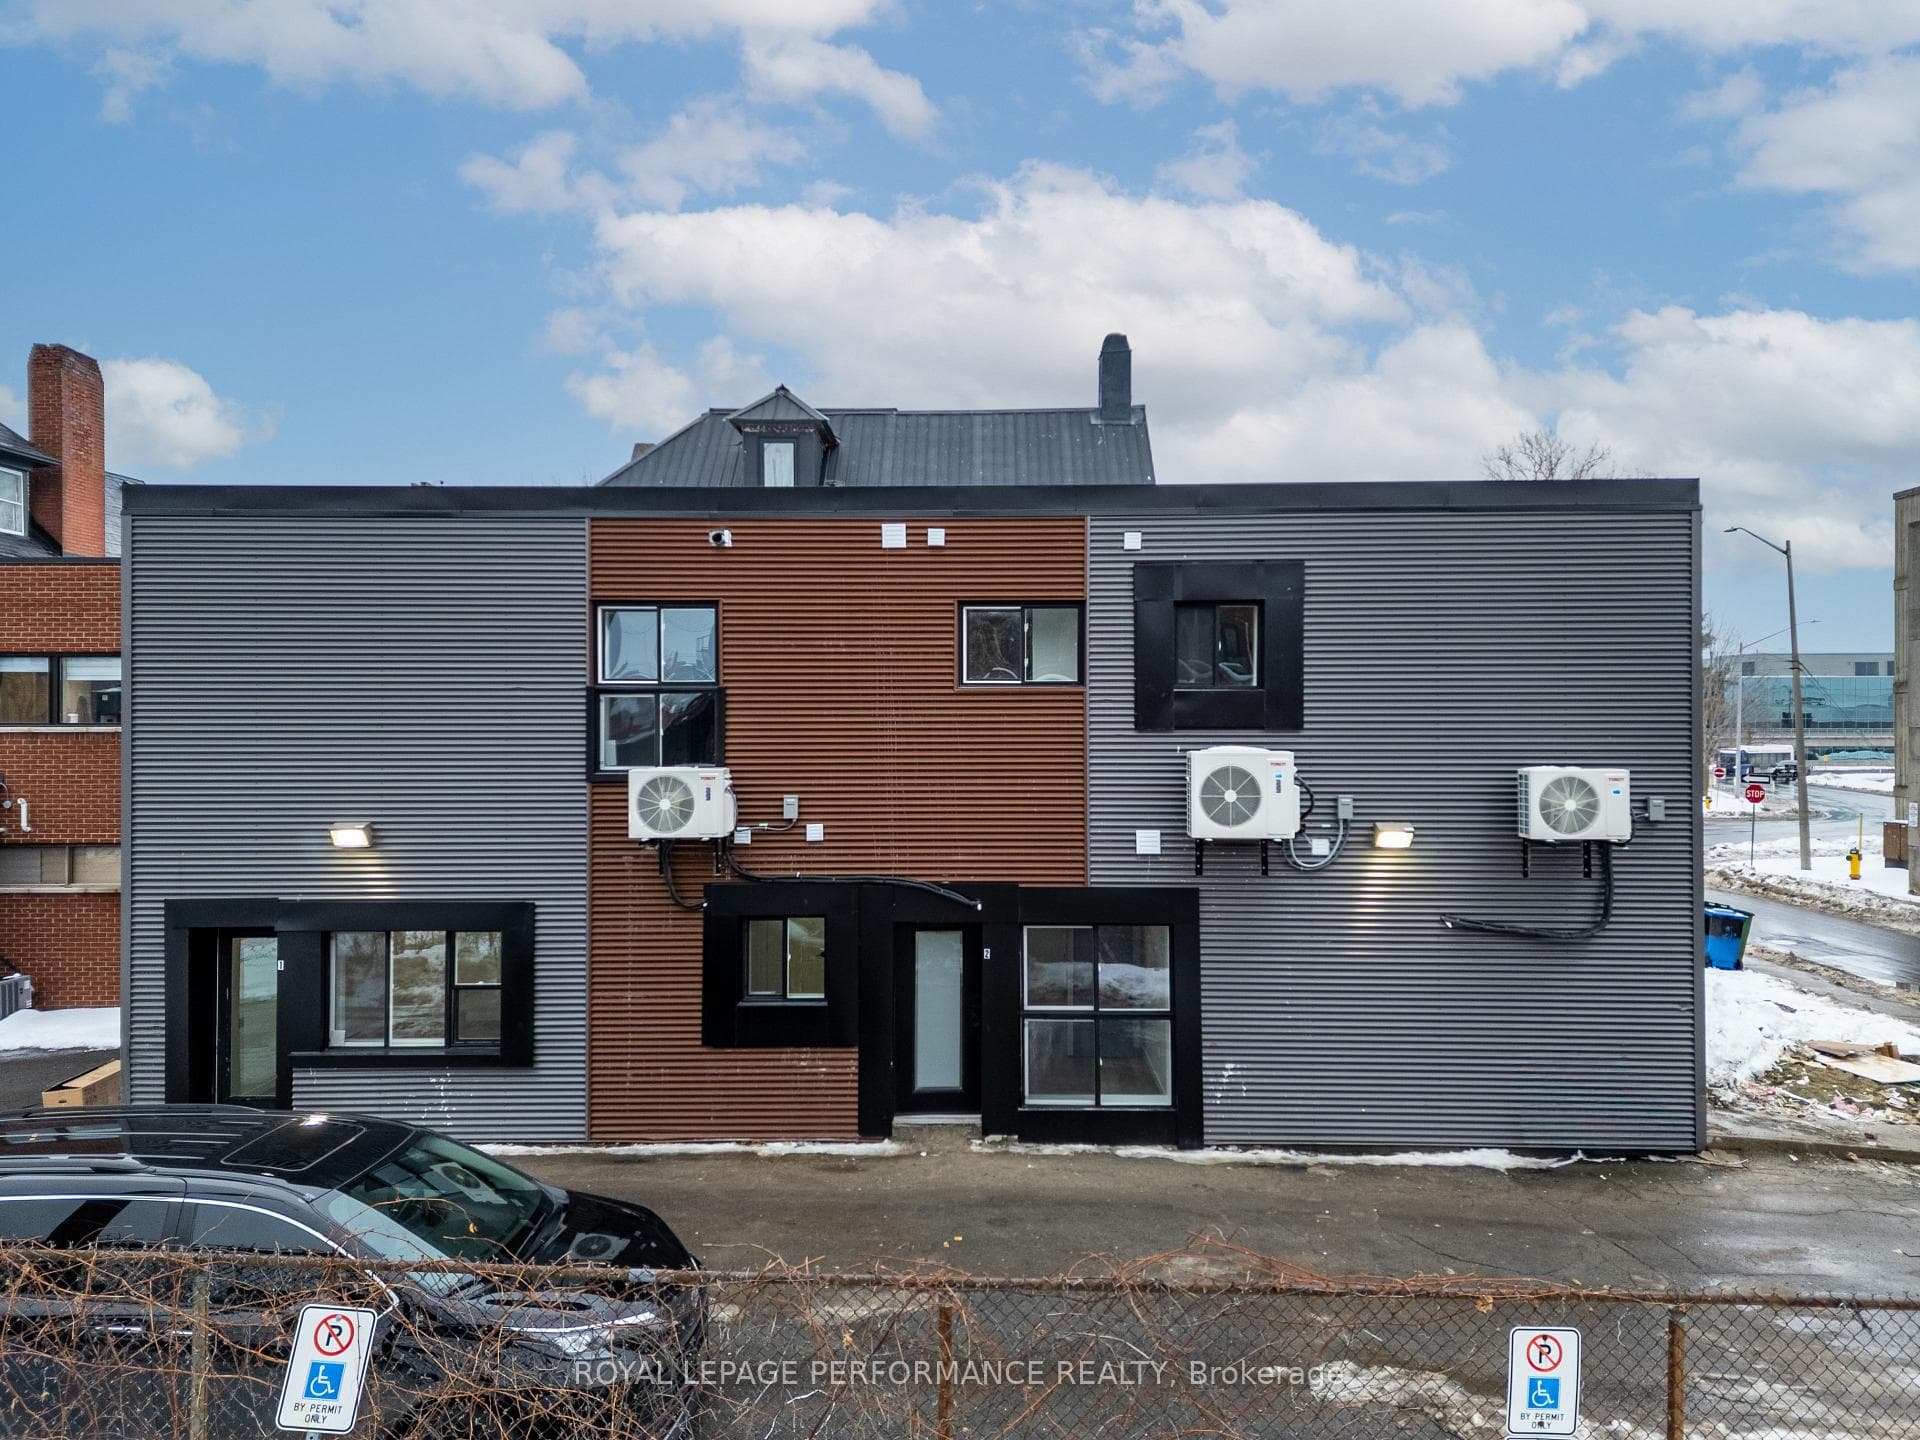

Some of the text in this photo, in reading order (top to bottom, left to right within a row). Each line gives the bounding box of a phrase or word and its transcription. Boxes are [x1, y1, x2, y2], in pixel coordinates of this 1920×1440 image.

[1747, 790, 1764, 798] STOP
[294, 1403, 342, 1414] BY PERMIT
